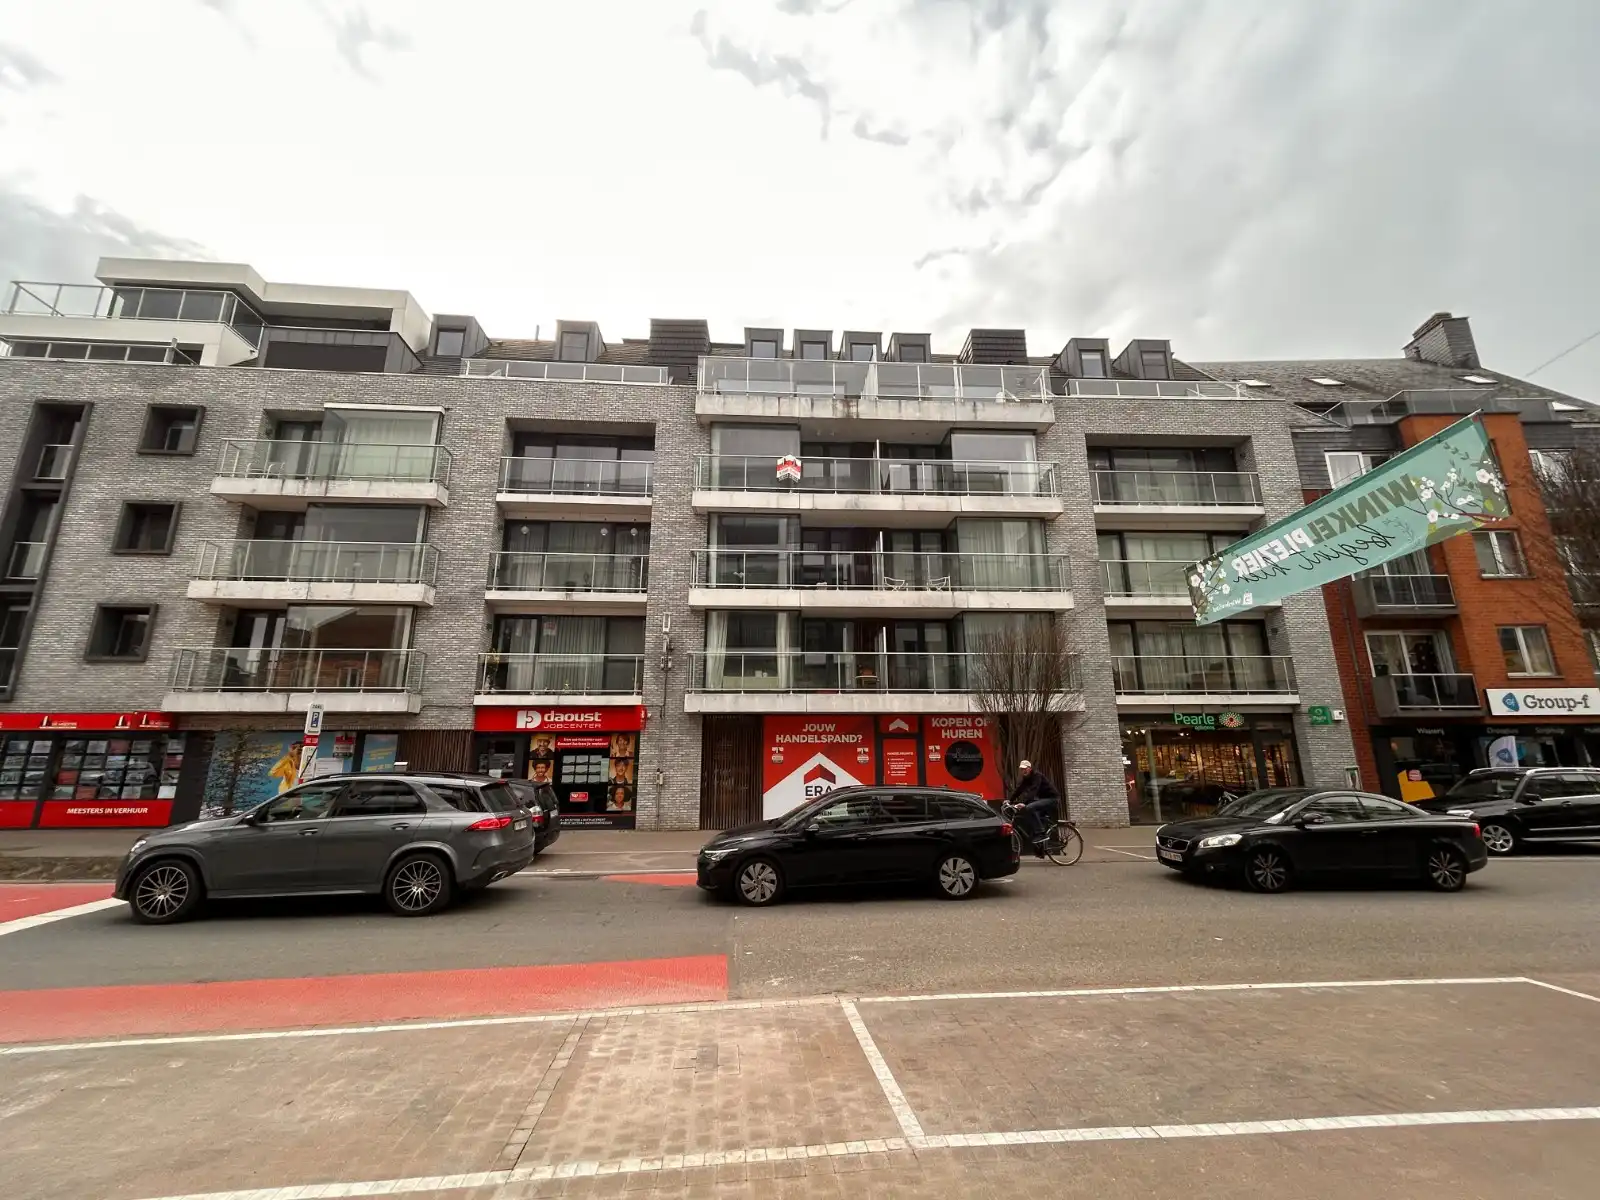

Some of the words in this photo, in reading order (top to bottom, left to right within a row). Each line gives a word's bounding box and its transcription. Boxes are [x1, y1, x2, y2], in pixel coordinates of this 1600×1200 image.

[1523, 694, 1590, 711] Group-f
[543, 710, 602, 722] daoust
[1173, 712, 1215, 726] Pearle
[802, 723, 836, 732] JOUW
[931, 717, 973, 727] KOPEN
[775, 734, 863, 743] HANDELSPAND?
[941, 728, 983, 739] HUREN
[805, 785, 833, 797] ERA
